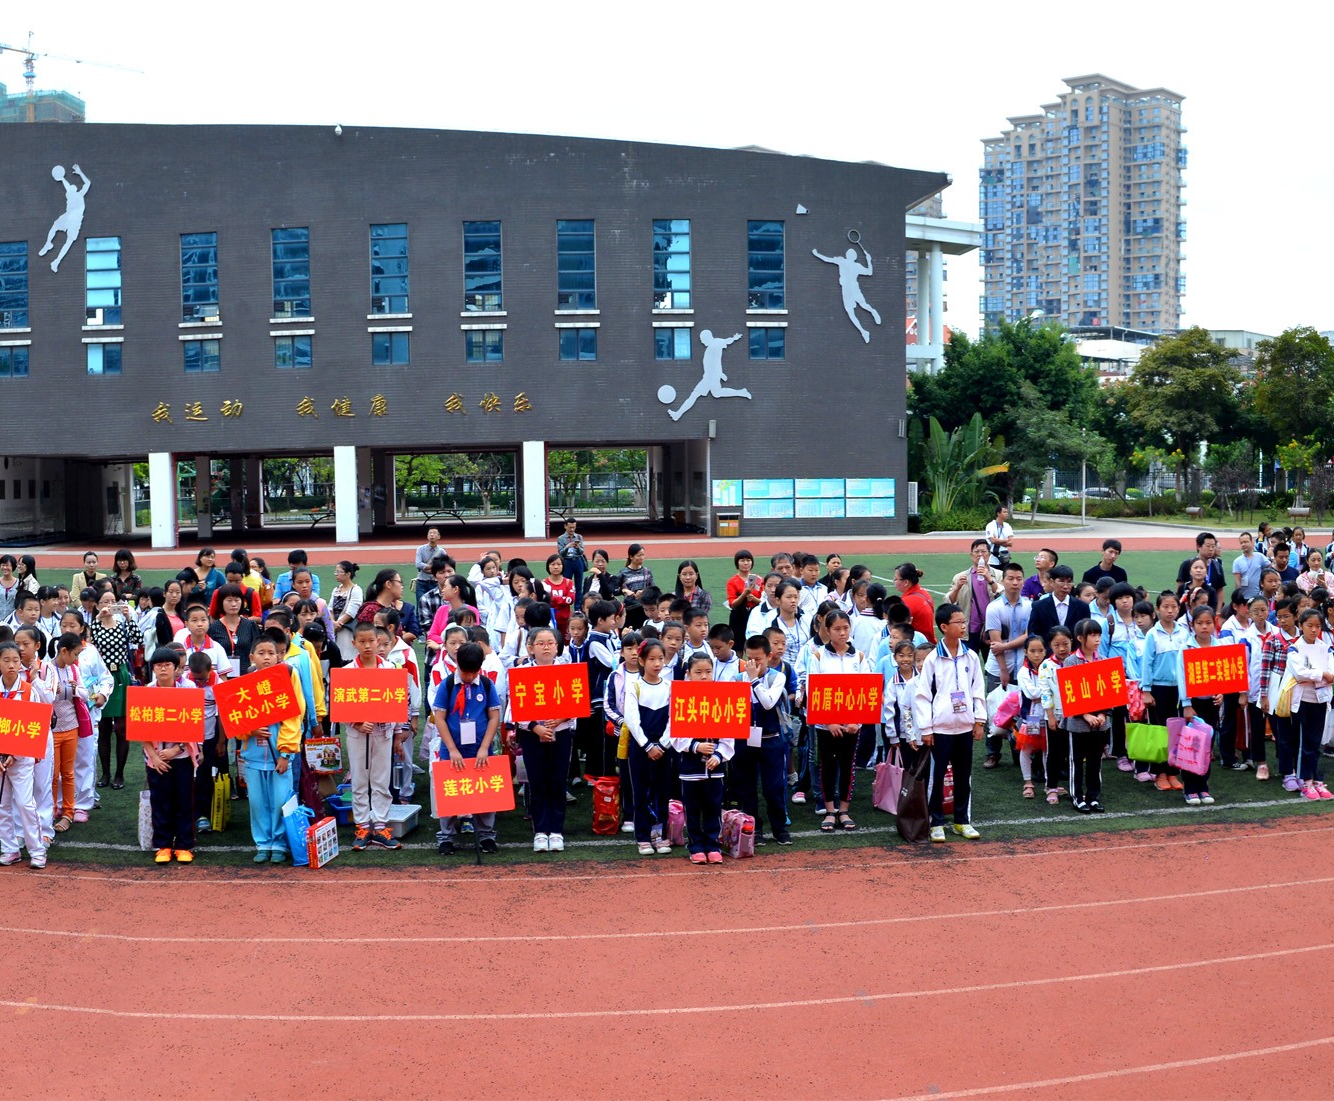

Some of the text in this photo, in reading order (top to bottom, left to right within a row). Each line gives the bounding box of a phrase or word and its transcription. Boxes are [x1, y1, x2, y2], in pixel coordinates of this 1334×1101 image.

[151, 392, 534, 424] 我运动 我健康 我快乐
[1187, 656, 1244, 685] 湖里第二实验小学
[333, 686, 406, 704] 演武第二小学
[515, 677, 584, 708] 宁宝小学
[1064, 669, 1122, 704] 兑山小学
[129, 706, 203, 725] 松柏第二小学
[228, 693, 291, 725] 中心小学
[674, 697, 747, 725] 江头中心小学
[443, 774, 505, 797] 莲花小学
